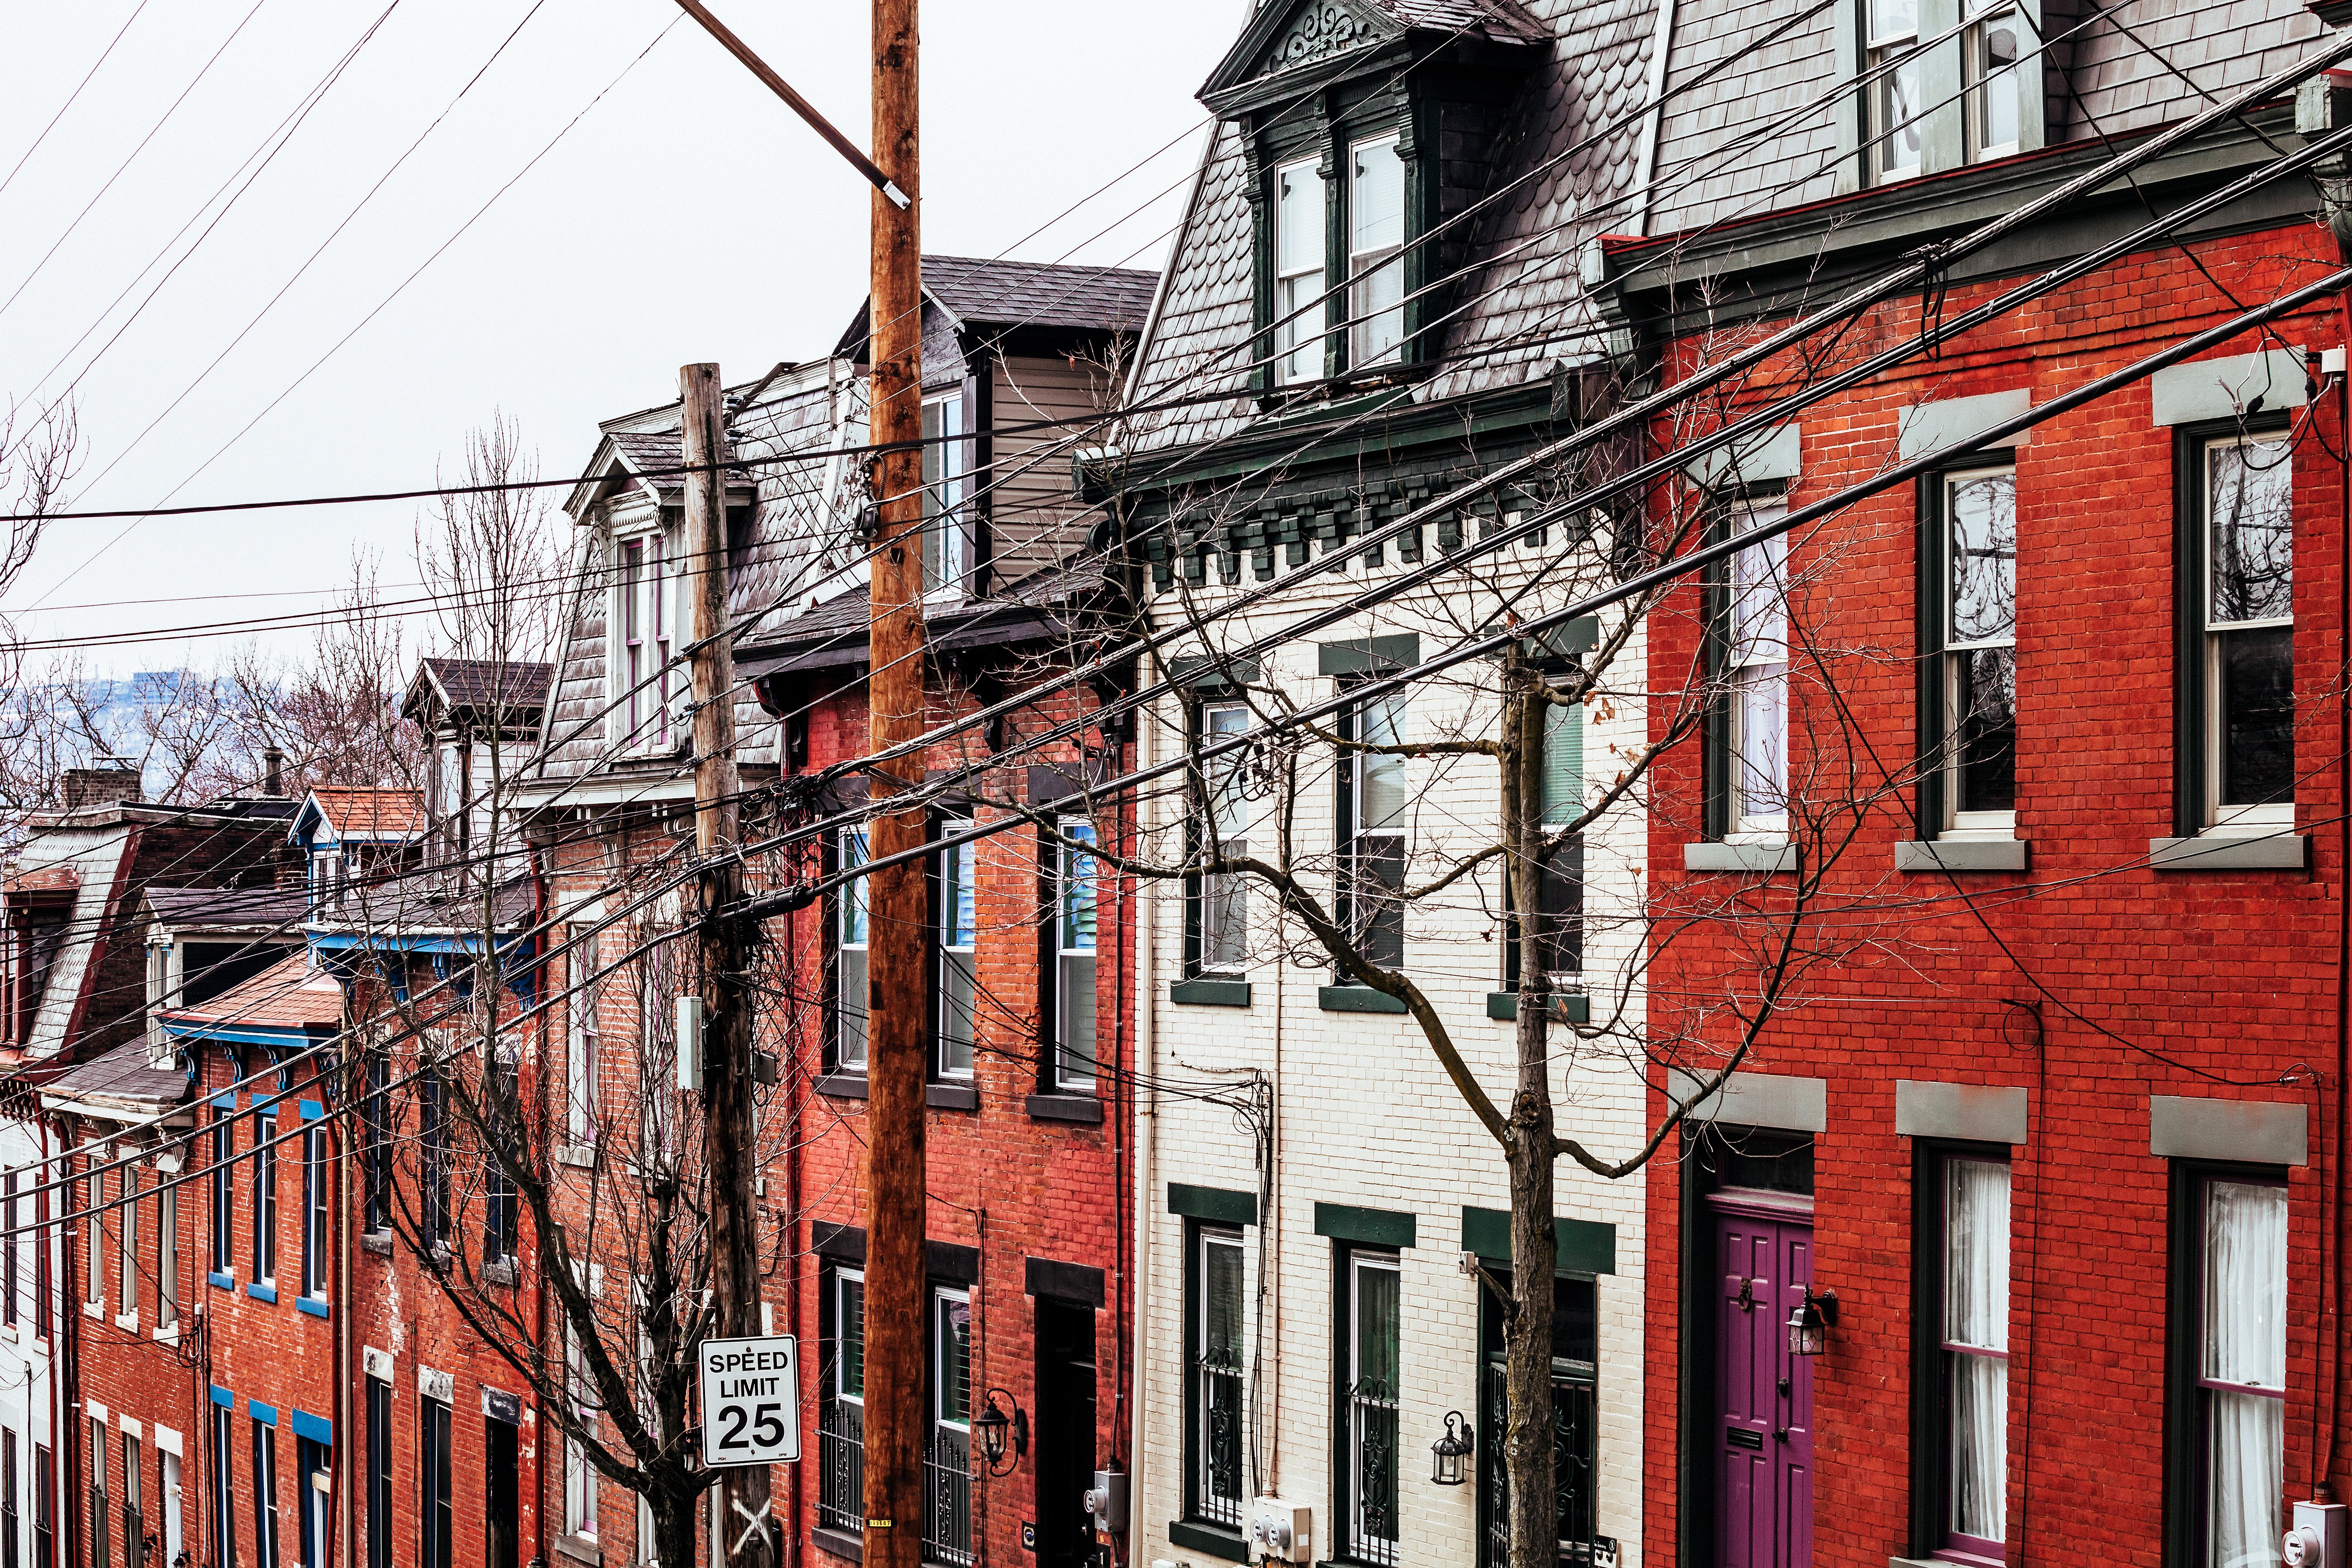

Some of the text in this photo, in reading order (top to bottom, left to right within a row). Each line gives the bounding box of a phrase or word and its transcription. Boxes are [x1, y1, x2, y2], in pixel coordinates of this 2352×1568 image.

[710, 1352, 788, 1373] SPEED
[720, 1378, 780, 1398] LIMIT
[718, 1403, 784, 1449] 25
